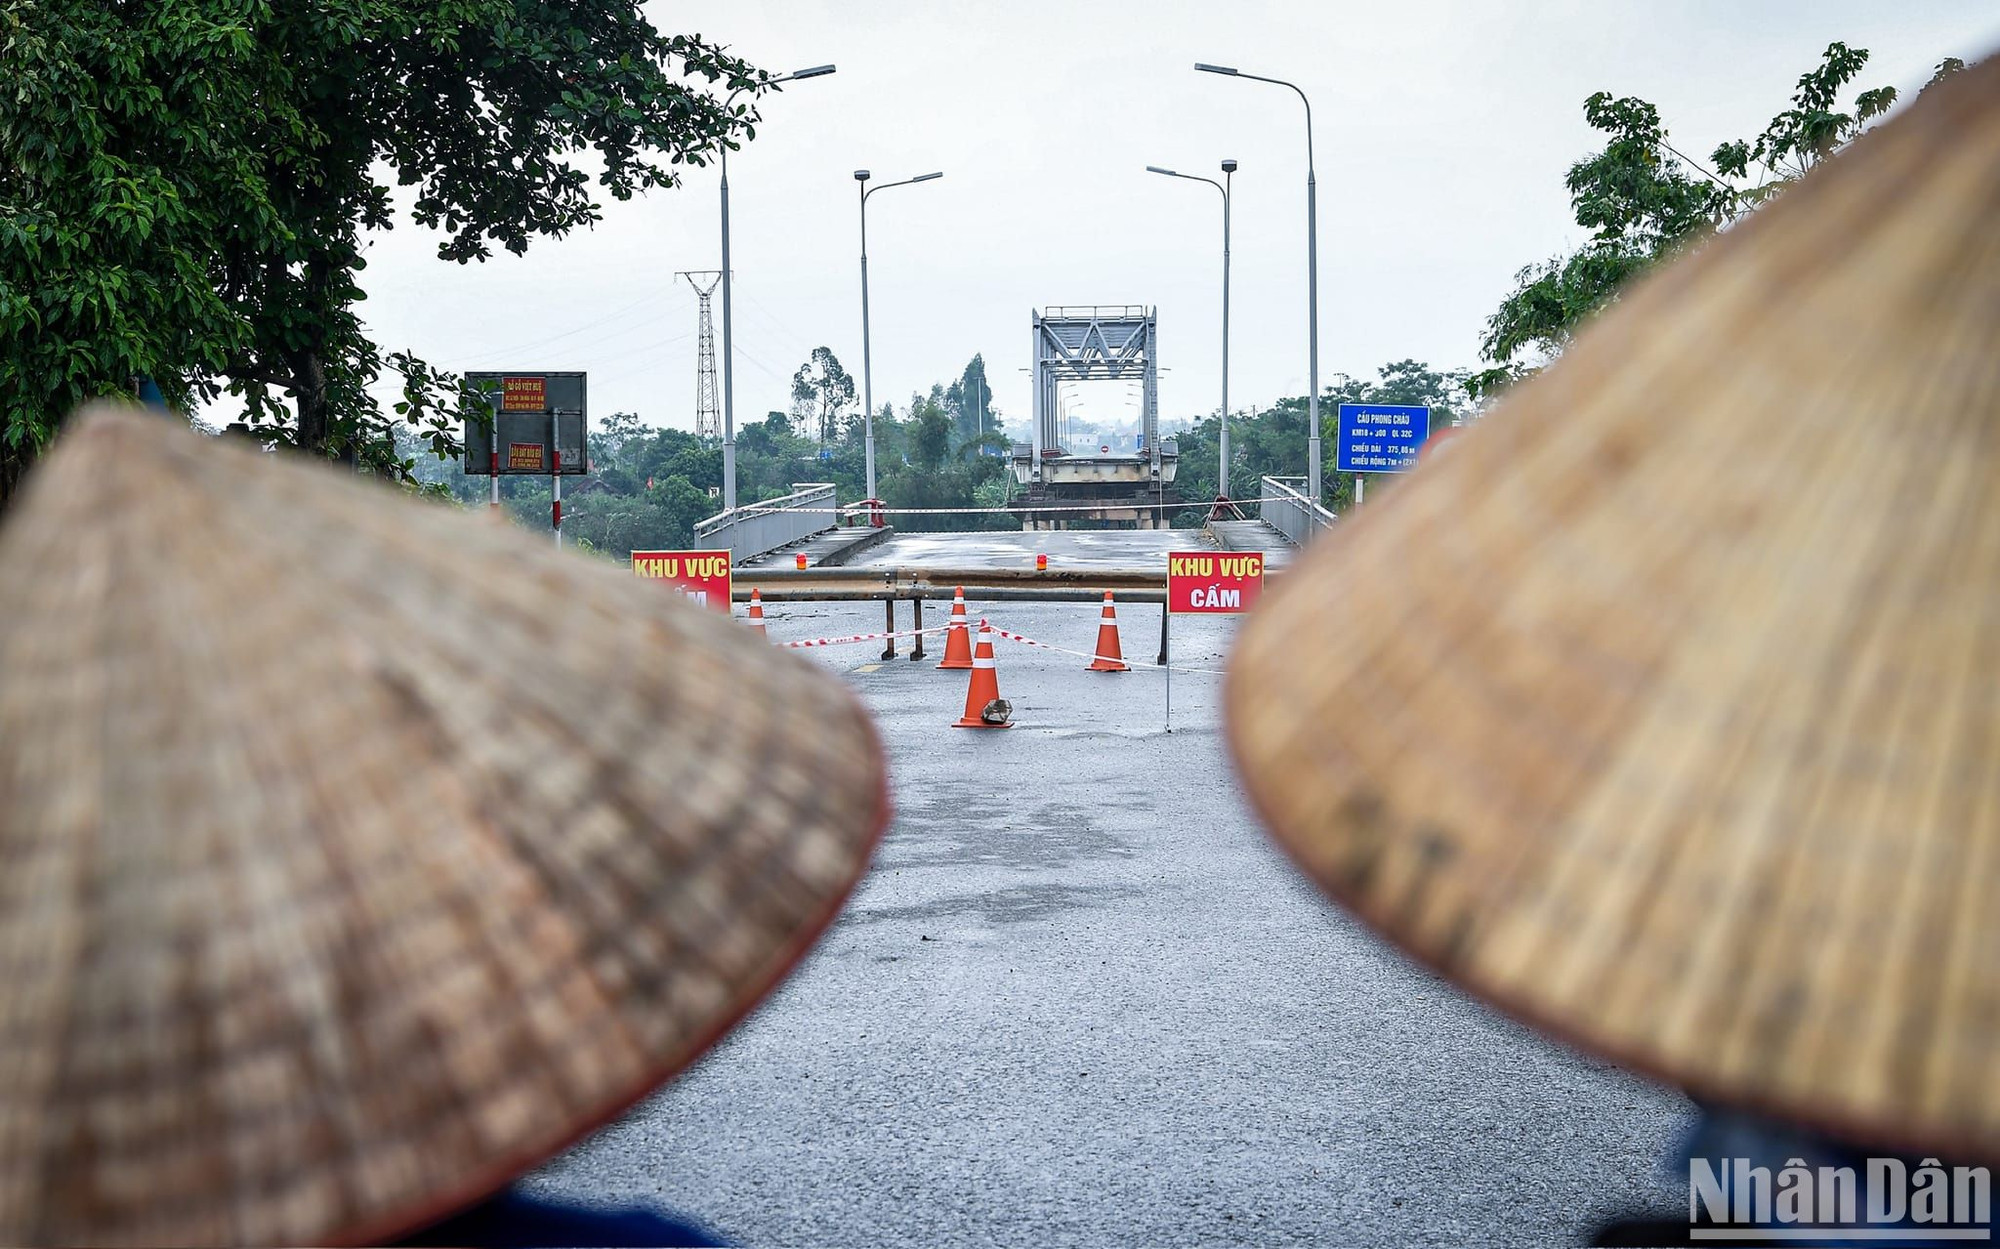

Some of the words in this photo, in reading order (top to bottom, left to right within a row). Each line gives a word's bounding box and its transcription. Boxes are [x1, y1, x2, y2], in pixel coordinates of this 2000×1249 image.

[1371, 414, 1392, 425] PHONG
[1401, 430, 1413, 438] 32C
[634, 559, 678, 578] KHU
[684, 556, 727, 582] VỰC
[1171, 558, 1213, 577] KHU
[1219, 556, 1260, 581] VỰC
[1190, 583, 1240, 608] CẤM
